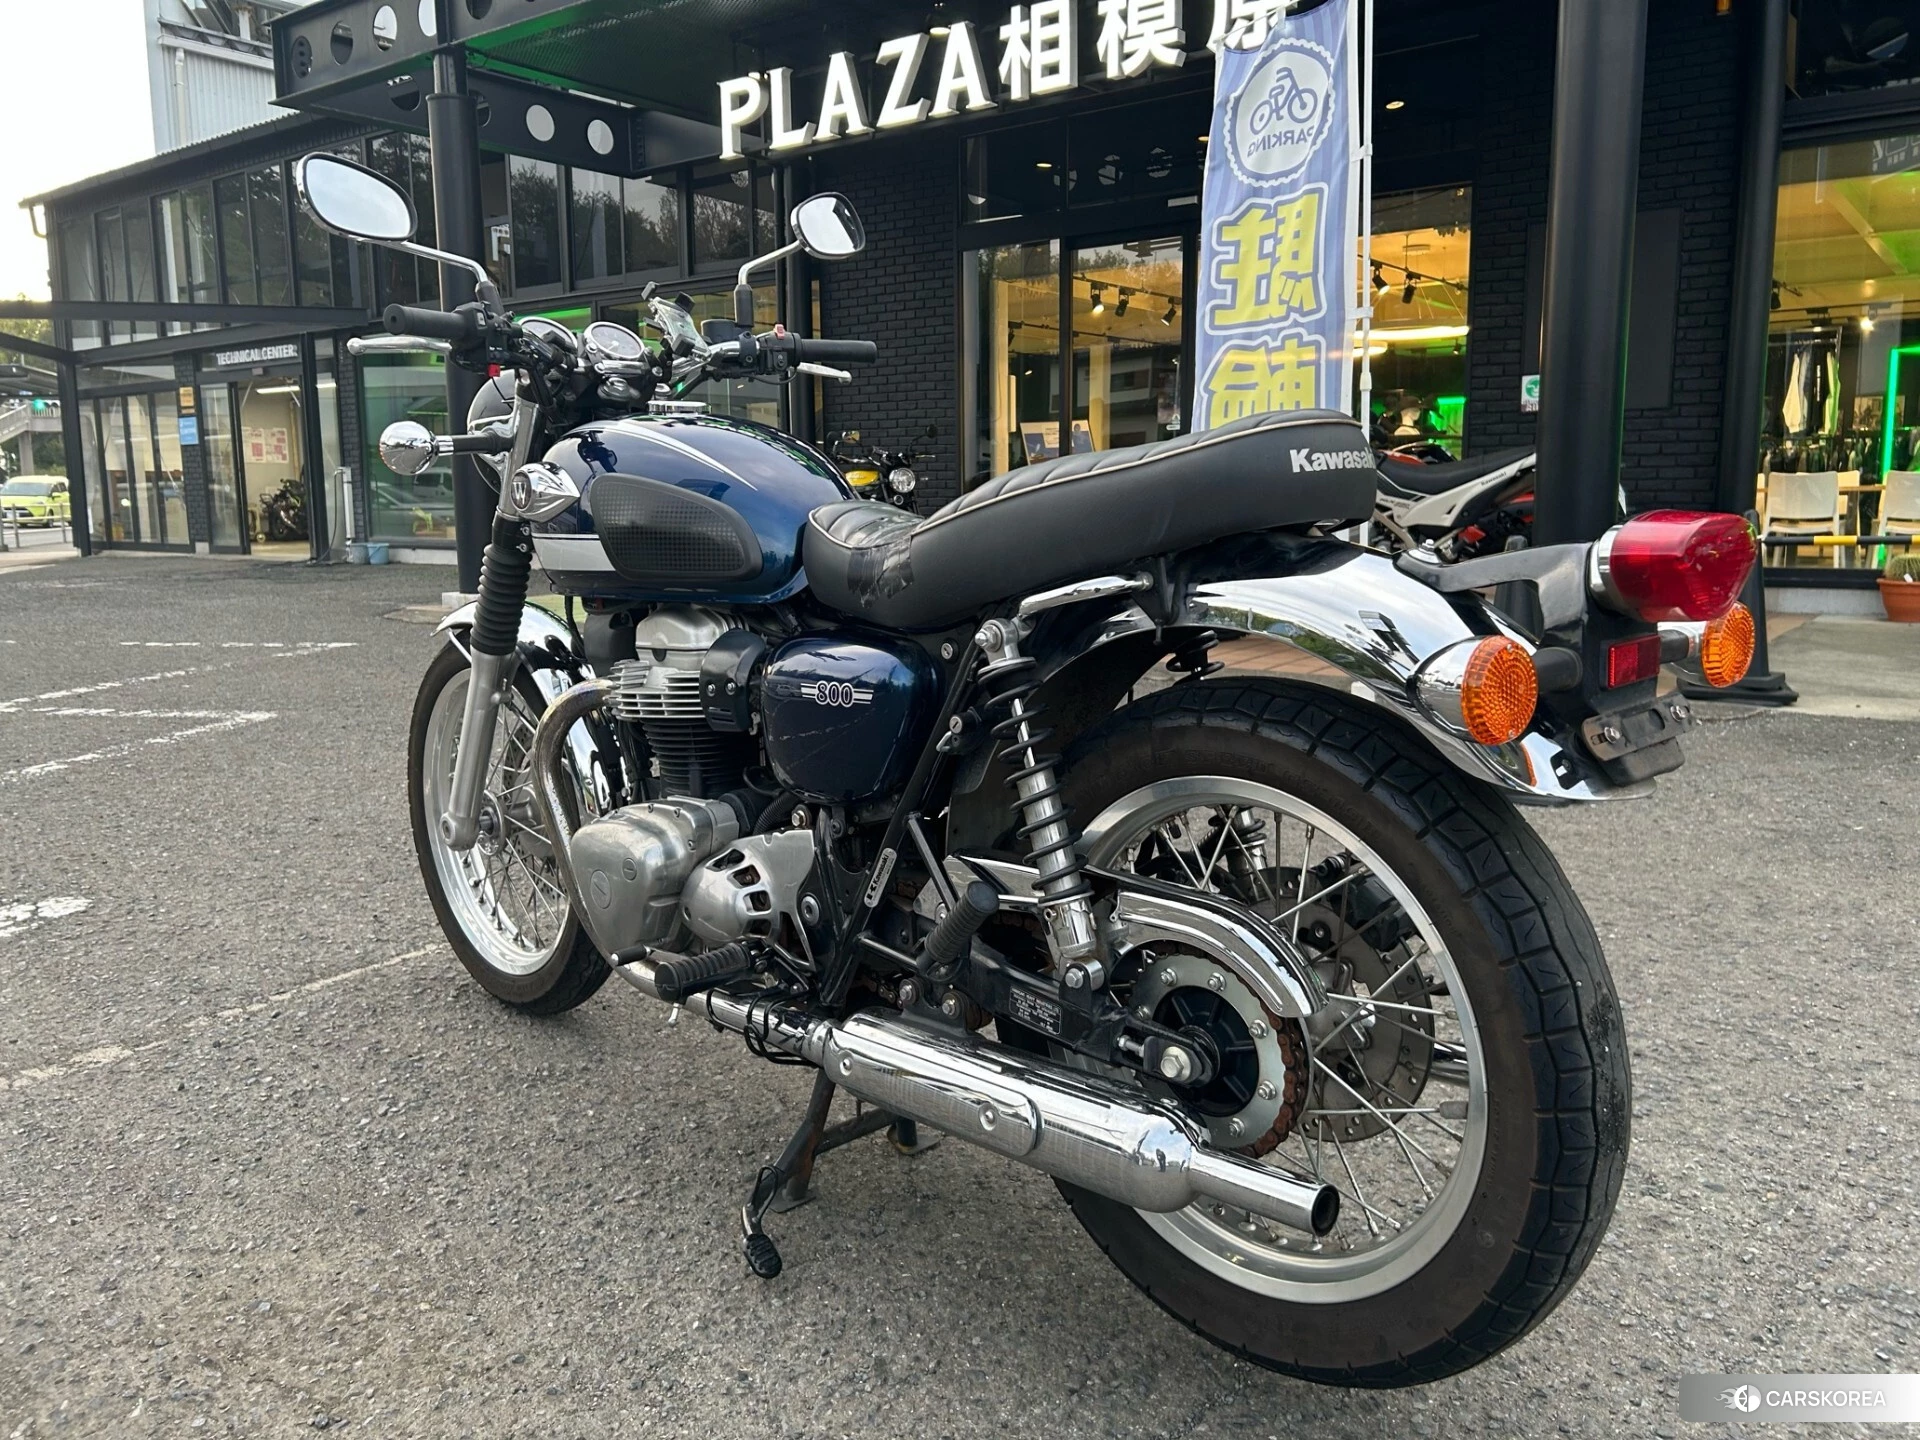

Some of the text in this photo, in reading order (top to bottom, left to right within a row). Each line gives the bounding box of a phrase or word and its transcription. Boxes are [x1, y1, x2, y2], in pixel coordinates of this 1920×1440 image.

[717, 21, 998, 160] PLAZA
[216, 344, 298, 365] TECHNICAL CENTER
[511, 481, 527, 505] W
[815, 680, 854, 708] 800
